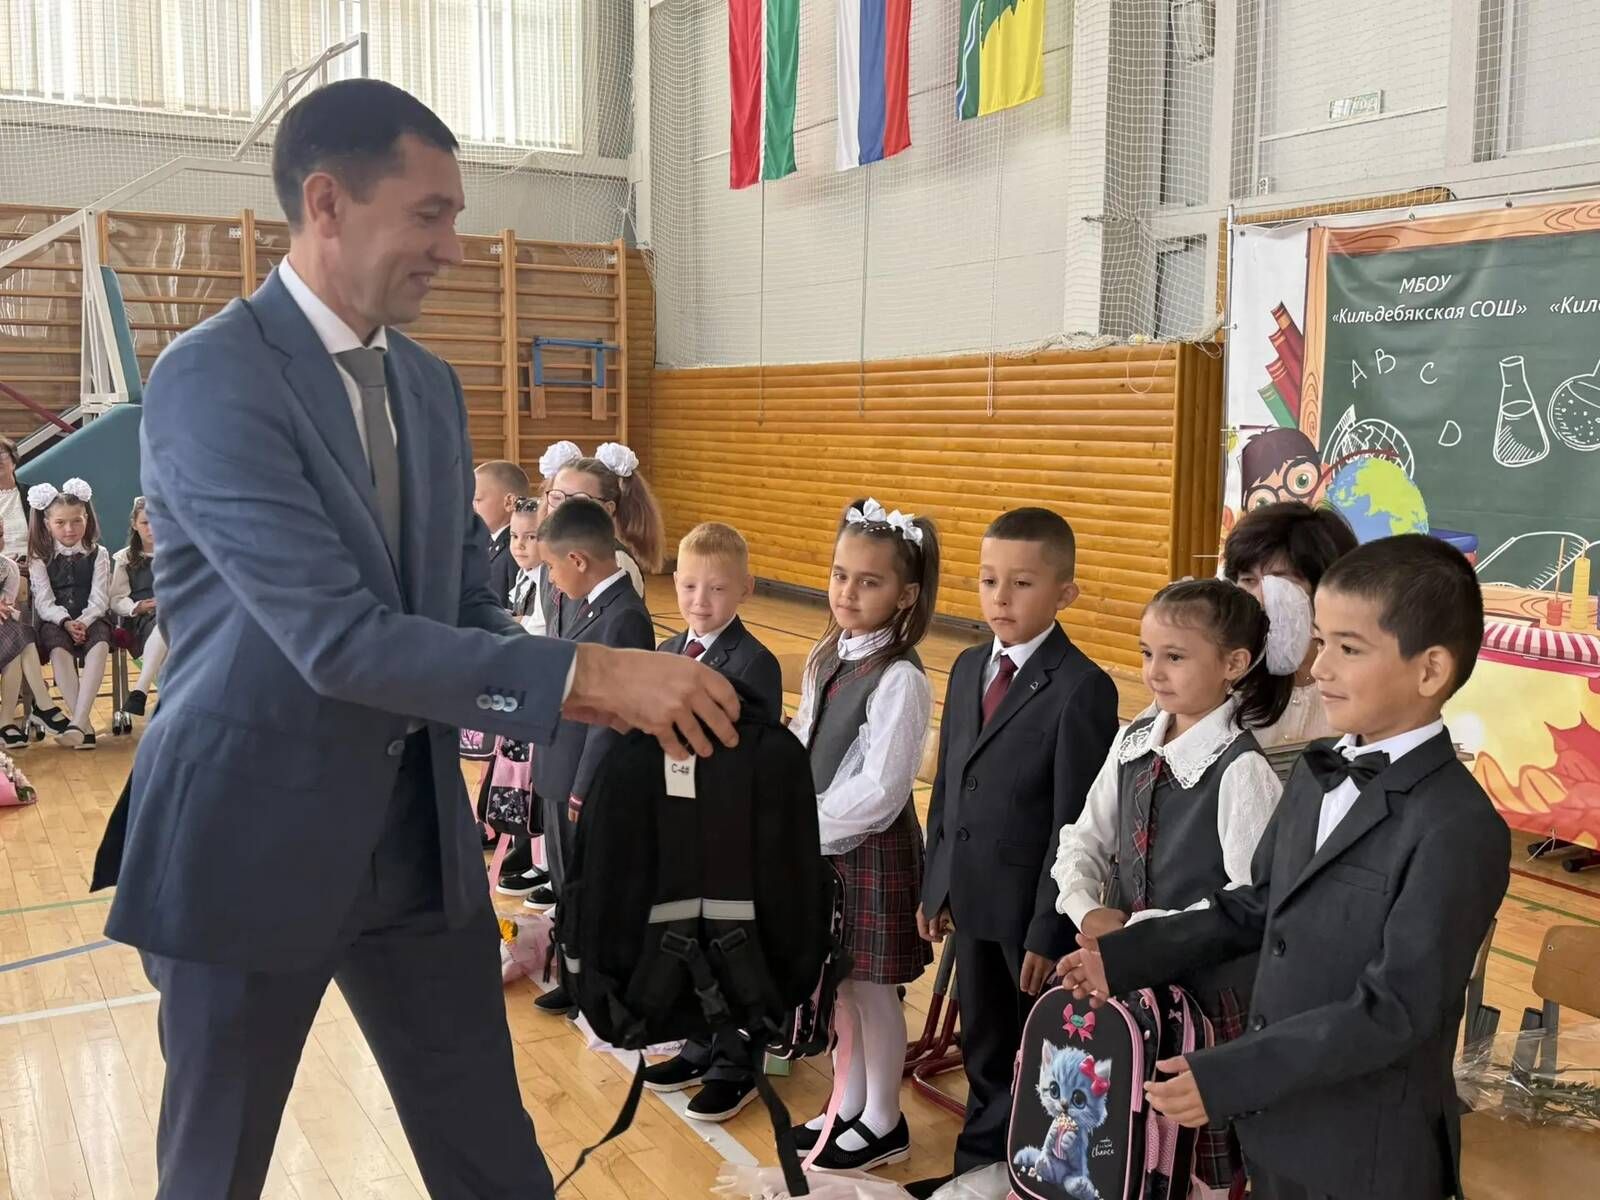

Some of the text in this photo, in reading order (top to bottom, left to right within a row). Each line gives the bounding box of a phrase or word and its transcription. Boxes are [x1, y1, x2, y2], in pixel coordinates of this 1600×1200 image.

[1399, 274, 1452, 294] МБОУ
[1332, 299, 1527, 324] «Кильдебякская СОШ»
[1550, 295, 1600, 314] «Кил
[1351, 348, 1438, 389] A B C
[1438, 420, 1462, 447] D
